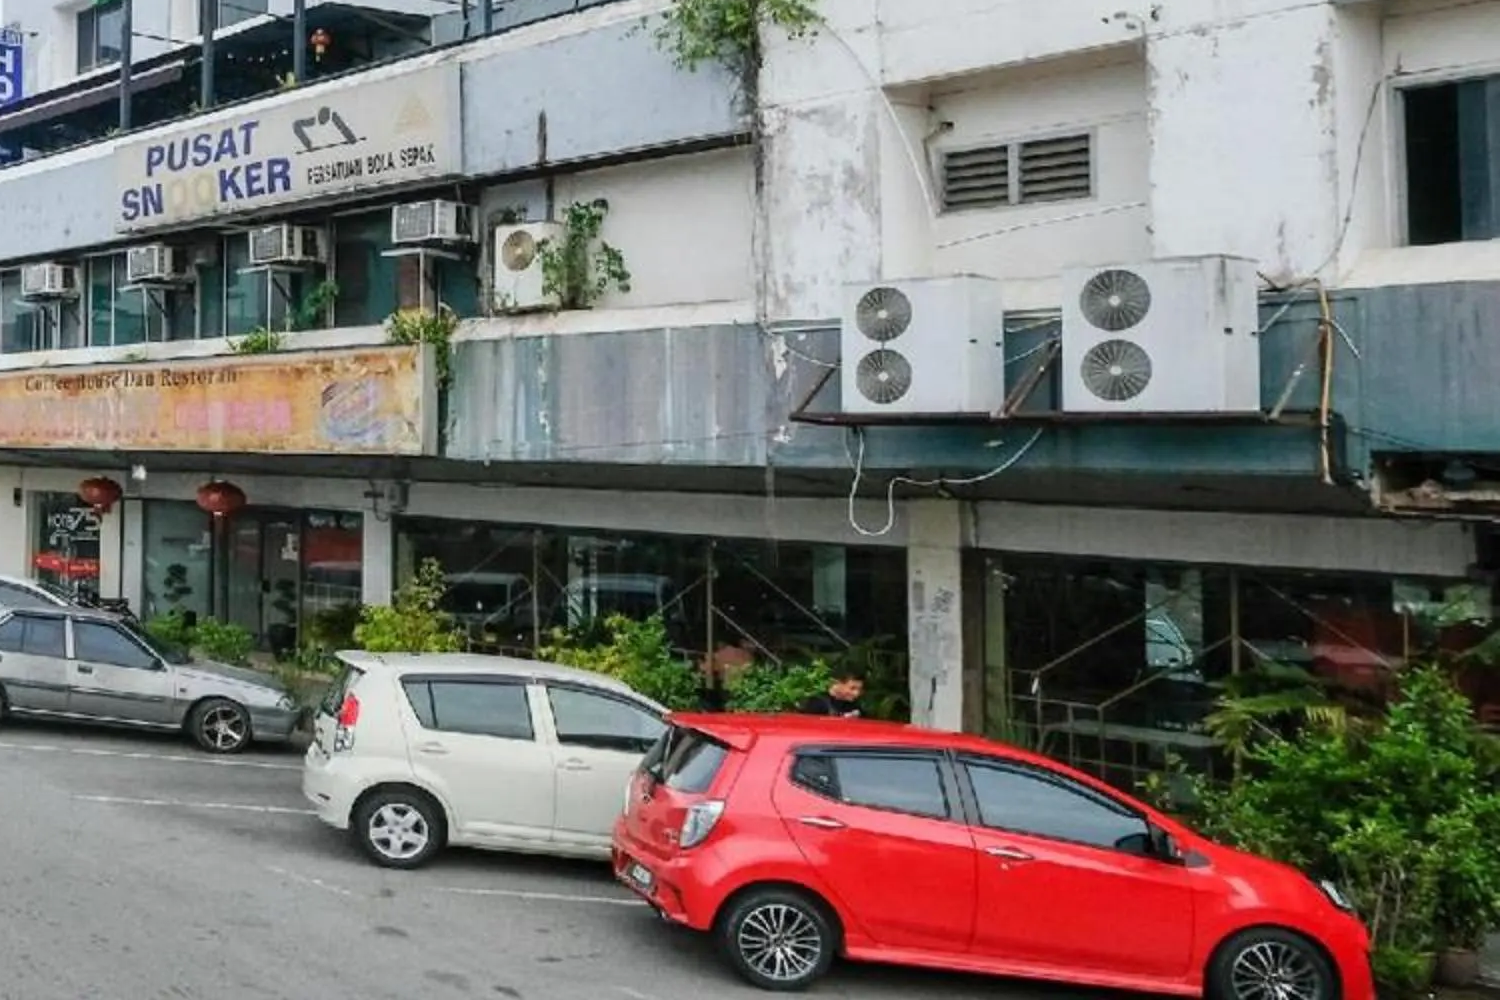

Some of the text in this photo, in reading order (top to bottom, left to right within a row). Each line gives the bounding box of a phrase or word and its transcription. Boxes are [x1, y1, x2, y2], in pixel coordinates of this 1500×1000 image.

[146, 121, 259, 176] PUSAT
[307, 143, 436, 185] PERSATUAN BOLA SEPAK
[121, 158, 291, 220] SNOOKER
